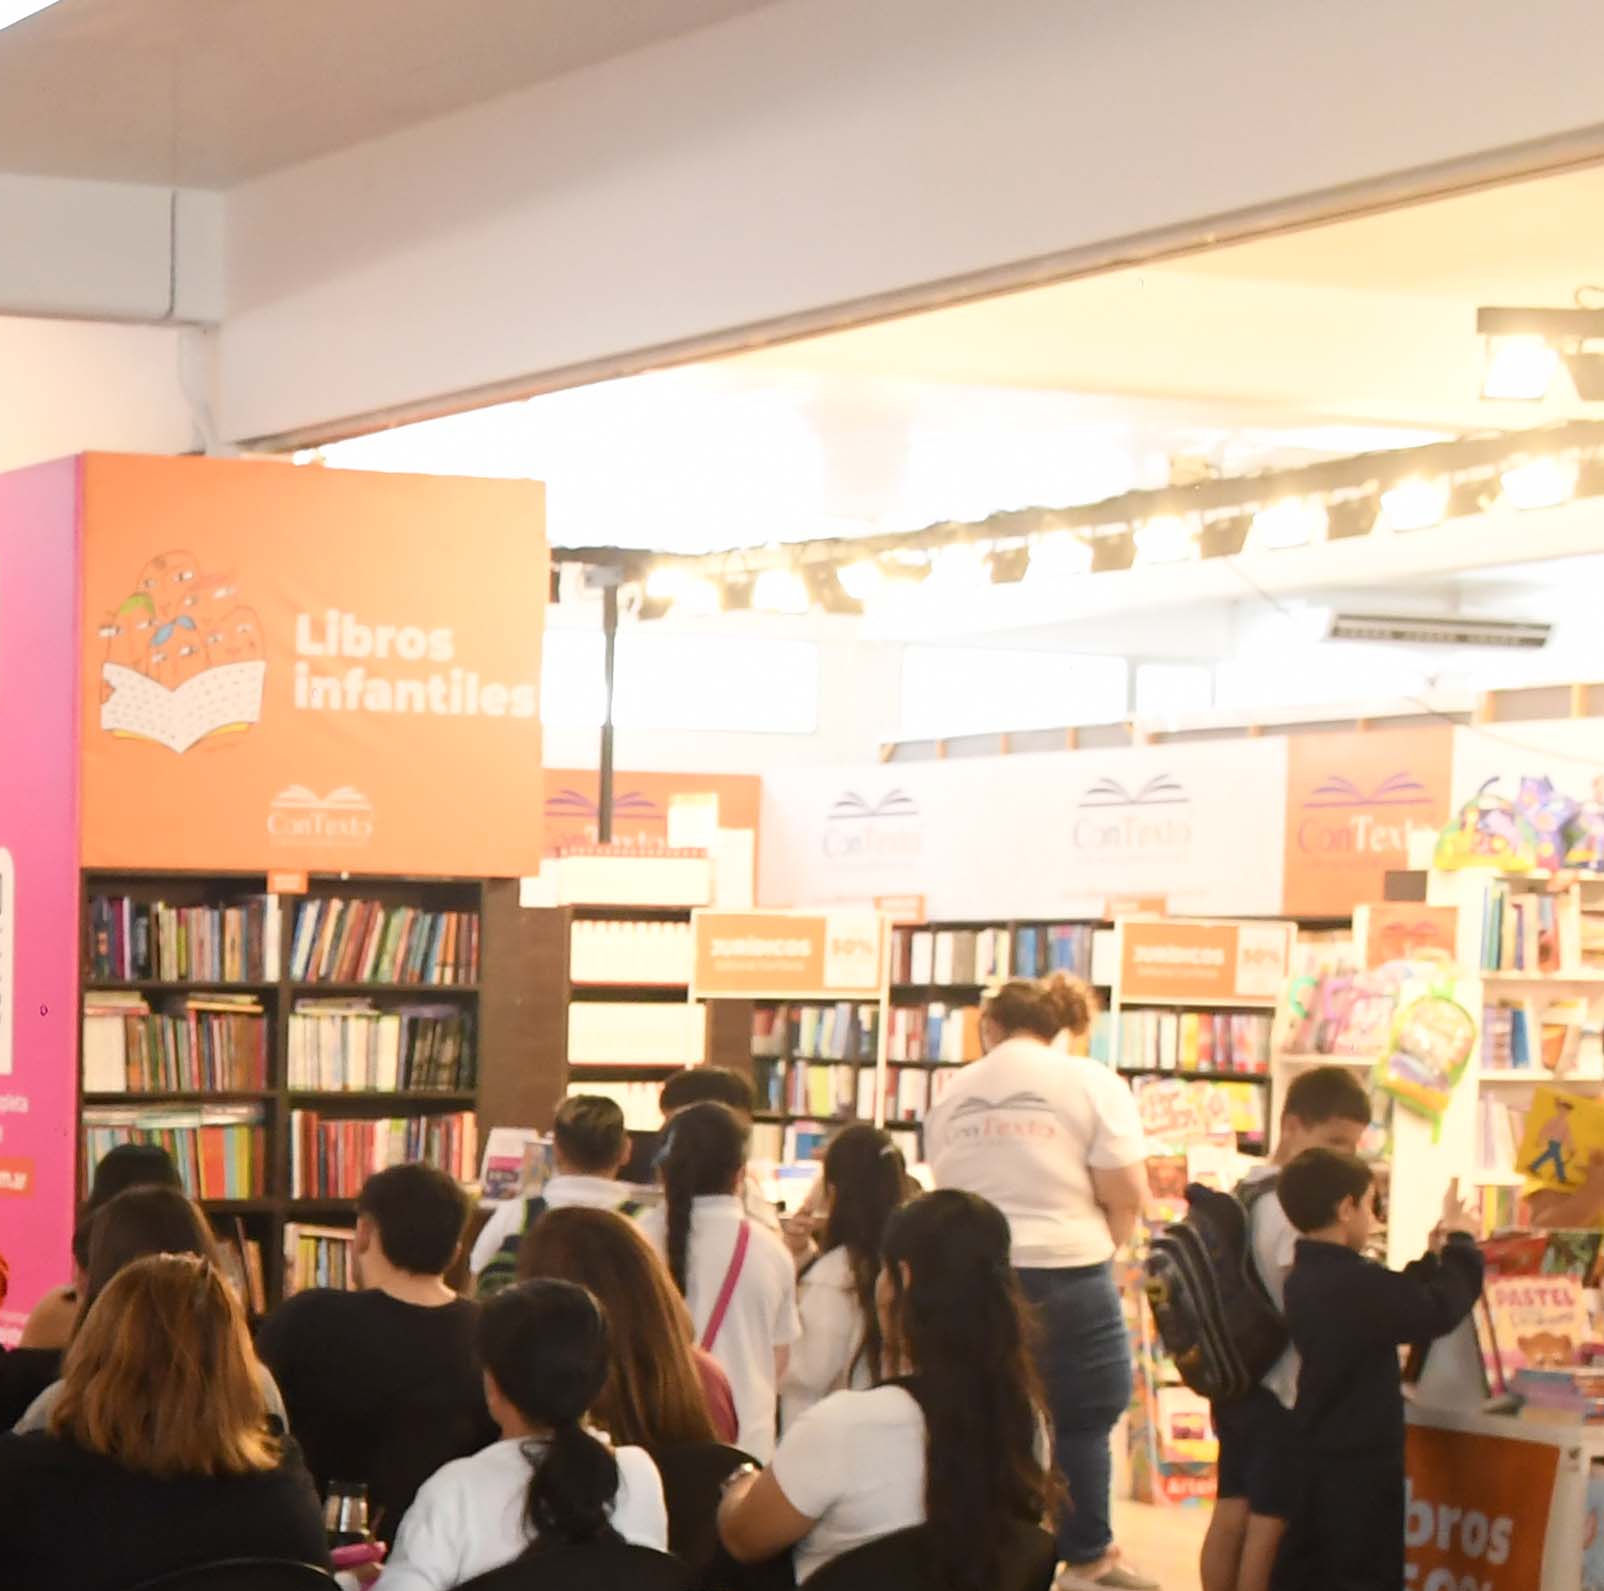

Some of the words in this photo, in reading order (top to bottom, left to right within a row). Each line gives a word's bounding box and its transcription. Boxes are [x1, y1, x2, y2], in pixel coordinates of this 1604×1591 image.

[295, 608, 456, 663] Libros
[294, 660, 538, 719] infantiles
[1403, 1476, 1514, 1566] bros
